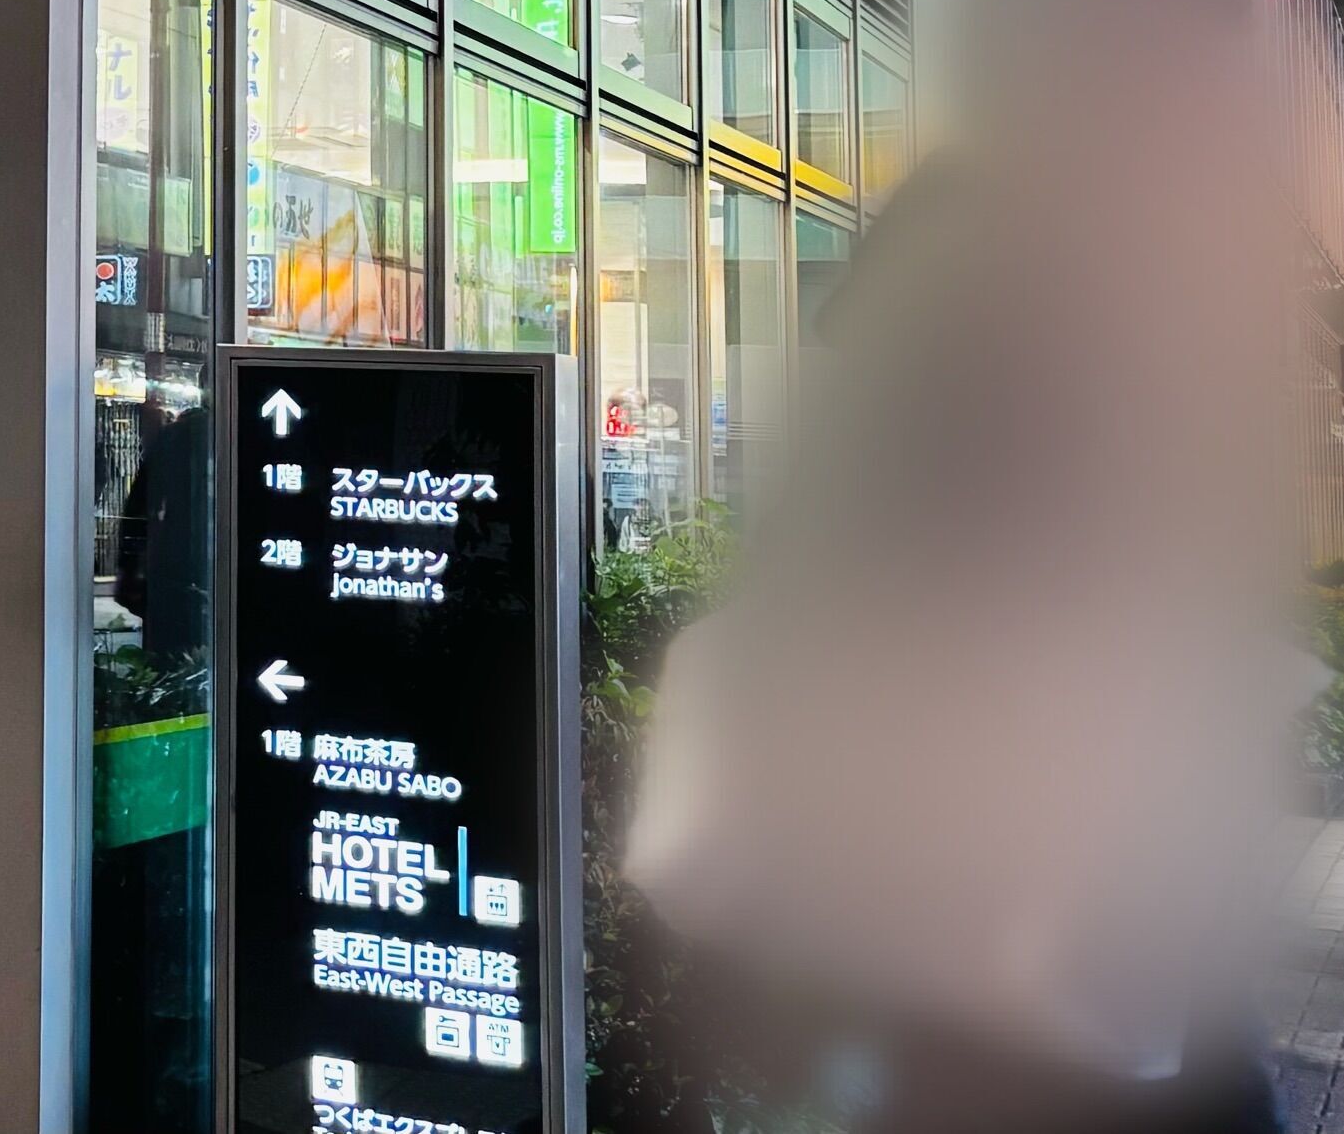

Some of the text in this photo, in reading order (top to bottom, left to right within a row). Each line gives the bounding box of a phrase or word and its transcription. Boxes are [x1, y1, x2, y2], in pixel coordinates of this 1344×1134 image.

[262, 463, 302, 490] 1階
[331, 467, 498, 500] スターバックス
[330, 496, 459, 523] STARBUCKS
[260, 538, 302, 567] 2階
[331, 542, 449, 575] ジョナサン
[261, 728, 302, 759] 1階
[313, 733, 416, 769] 麻布茶房
[313, 764, 462, 799] AZABU SABO
[313, 810, 400, 837] JR-EAST
[312, 830, 450, 880] HOTEL
[312, 866, 424, 913] METS
[313, 928, 519, 989] 東西自由通路
[313, 964, 520, 1016] East-West Passage
